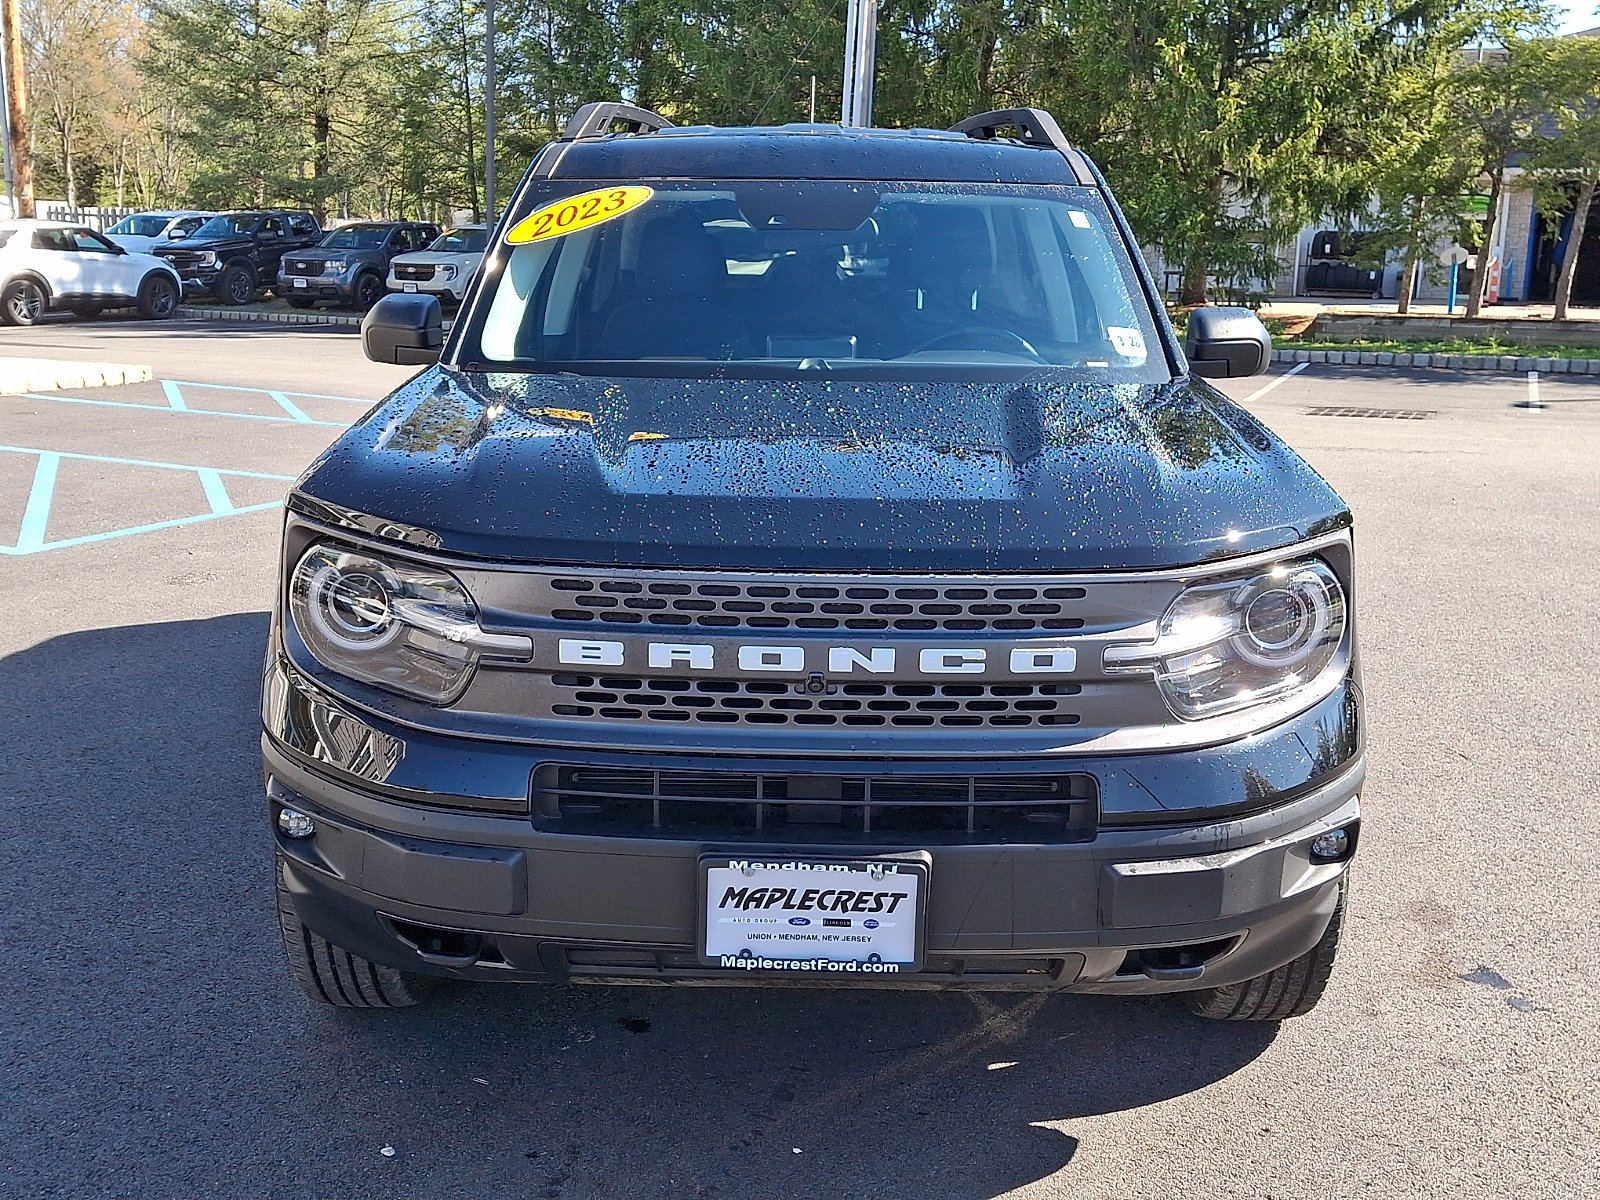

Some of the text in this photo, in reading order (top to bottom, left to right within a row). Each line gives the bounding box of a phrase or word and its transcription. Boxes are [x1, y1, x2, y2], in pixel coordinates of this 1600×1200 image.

[531, 190, 627, 239] 2023
[558, 638, 1077, 674] BRONCO
[728, 860, 898, 875] Mendham, NJ
[718, 886, 909, 915] MAPLECREST
[778, 933, 820, 942] MENDHAM,
[822, 934, 840, 942] NEW
[841, 935, 872, 943] JERSEY
[720, 955, 900, 973] MaplecrestFord.com
